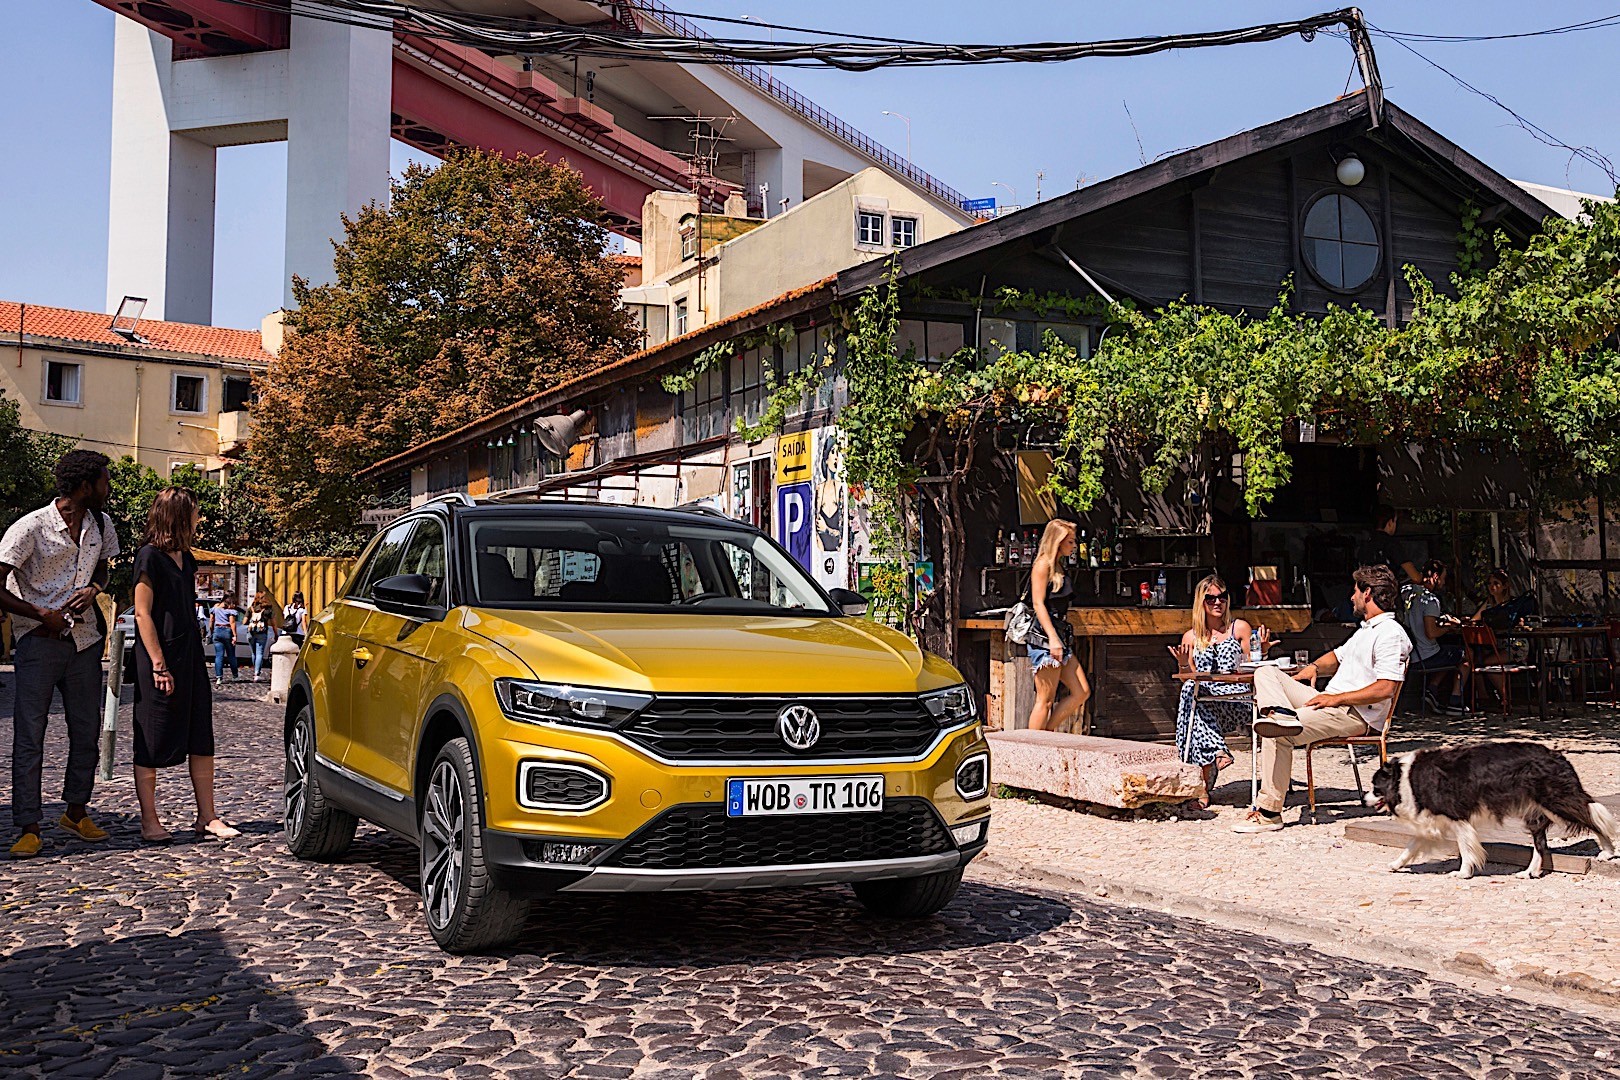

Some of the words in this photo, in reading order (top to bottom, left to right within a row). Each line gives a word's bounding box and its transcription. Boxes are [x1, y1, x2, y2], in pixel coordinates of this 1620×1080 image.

[783, 440, 806, 457] SAÍDA
[784, 492, 804, 554] P
[732, 801, 740, 810] D
[747, 783, 791, 811] WOB
[809, 783, 836, 810] TR
[842, 781, 881, 808] 106
